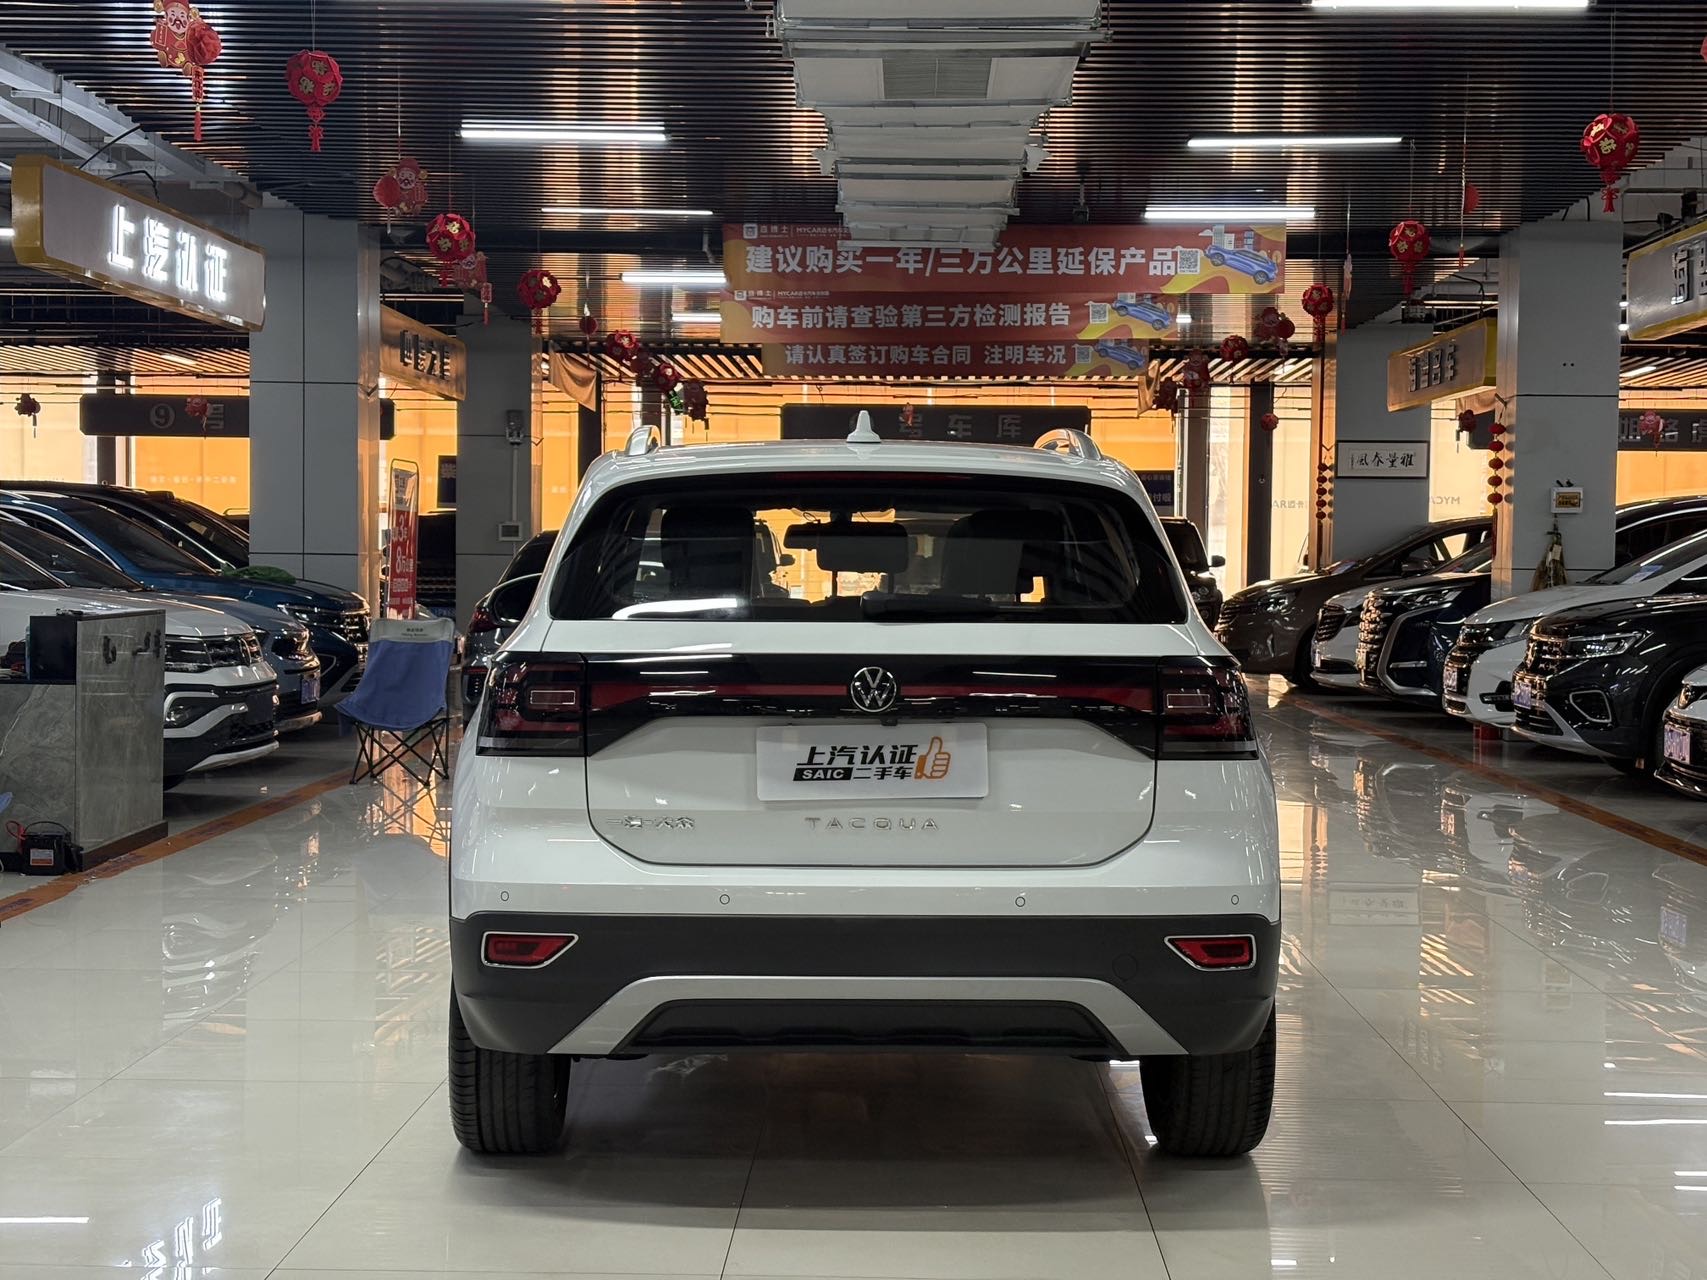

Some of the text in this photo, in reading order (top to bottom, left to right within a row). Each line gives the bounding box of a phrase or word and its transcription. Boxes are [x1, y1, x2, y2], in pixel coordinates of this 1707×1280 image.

[107, 204, 228, 302] 上汽认证
[745, 244, 1177, 277] 建议购买一年/三万公里延保产品
[752, 304, 1071, 329] 购车前请查验第三方检测报告
[785, 344, 1066, 365] 请认真签订购车合同 注明车况
[796, 744, 919, 766] 上汽认证
[802, 767, 914, 780] SAIC 二手车
[804, 817, 939, 831] TACQUA
